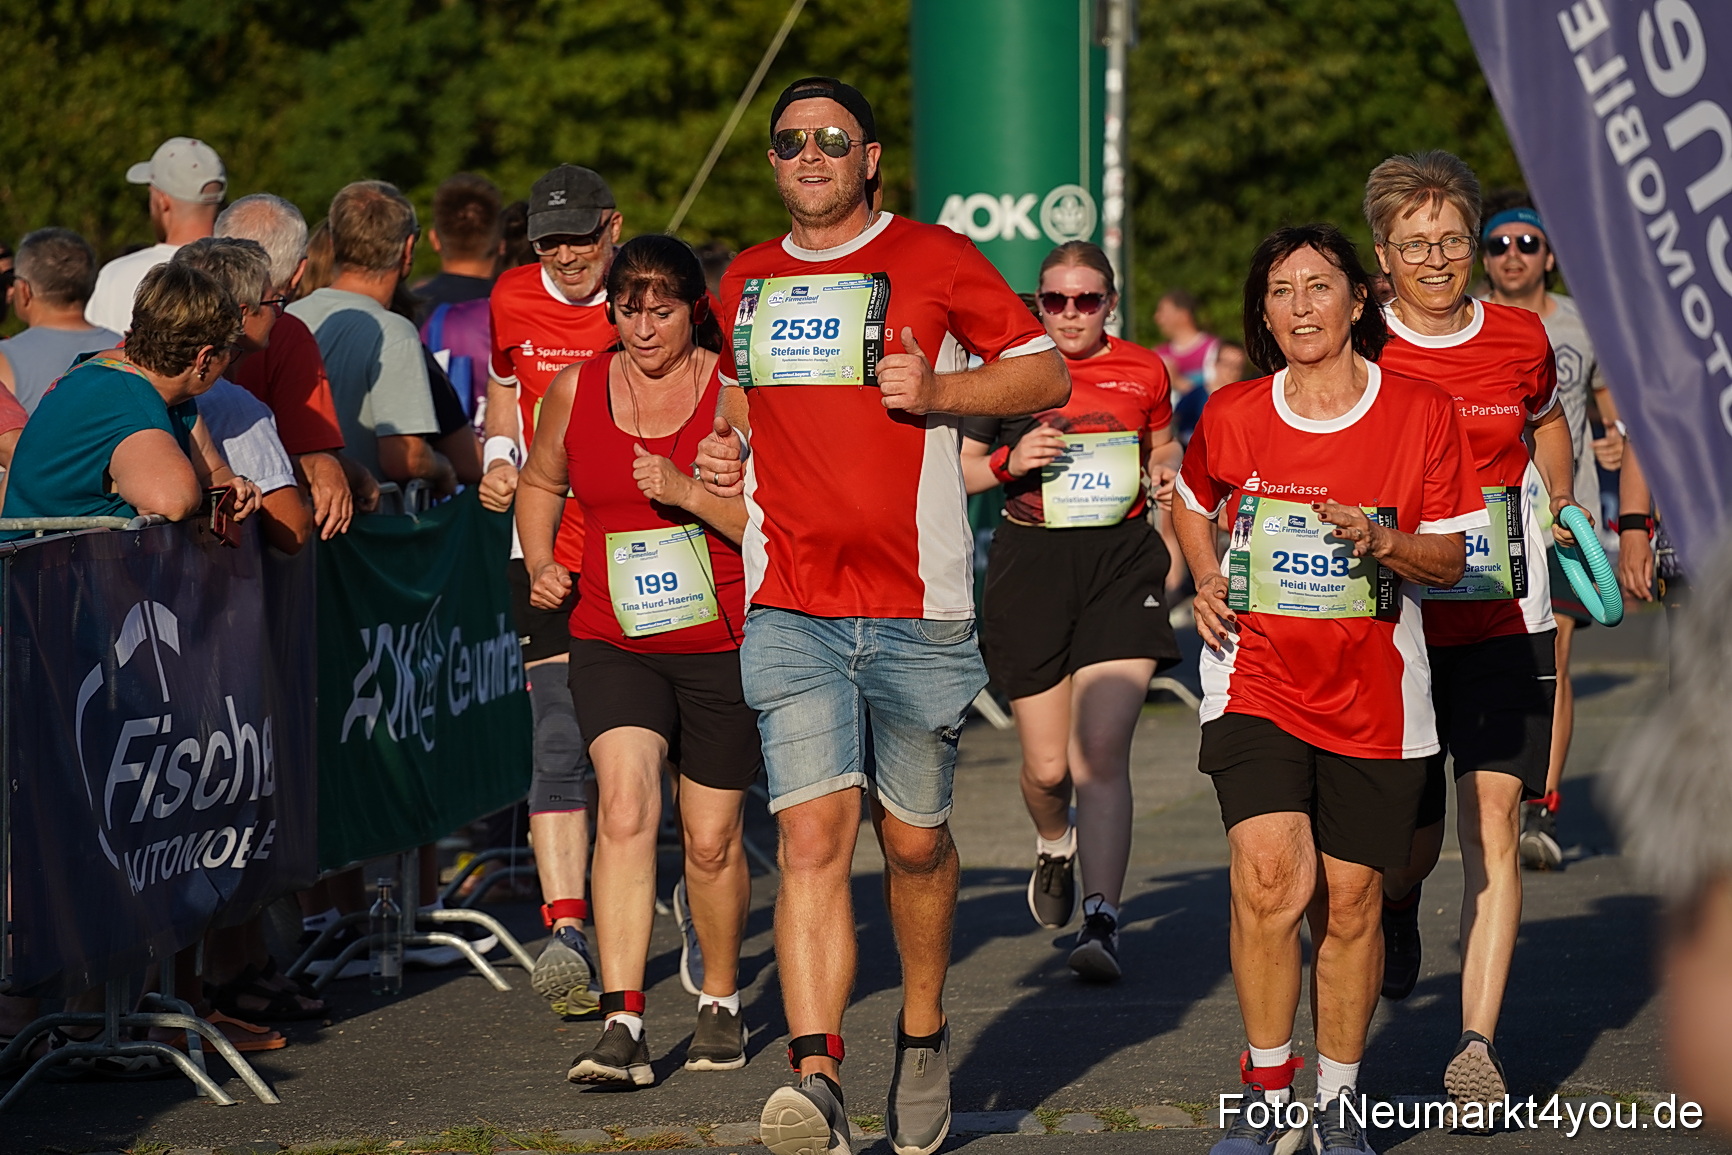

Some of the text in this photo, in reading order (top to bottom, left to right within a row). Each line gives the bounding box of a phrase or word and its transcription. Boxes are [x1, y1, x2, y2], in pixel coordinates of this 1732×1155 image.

[935, 193, 1041, 242] AOK
[771, 318, 840, 341] 2538
[536, 347, 593, 358] Sparkasse
[771, 346, 840, 357] Stefanie Beyer
[1068, 472, 1111, 491] 724
[1261, 481, 1328, 495] Sparkasse
[1091, 495, 1131, 504] Weininger
[1240, 504, 1255, 512] AOK
[1282, 527, 1320, 535] Firmenlauf
[628, 550, 659, 560] Firmenlauf
[1272, 550, 1350, 577] 2593
[1465, 563, 1502, 573] Grasruck
[1513, 558, 1522, 591] HILTL
[635, 571, 678, 596] 199
[1280, 579, 1346, 592] Heidi Walter
[621, 602, 640, 611] Tina
[641, 593, 704, 610] Hurd-Haering
[1381, 581, 1389, 610] HILTL
